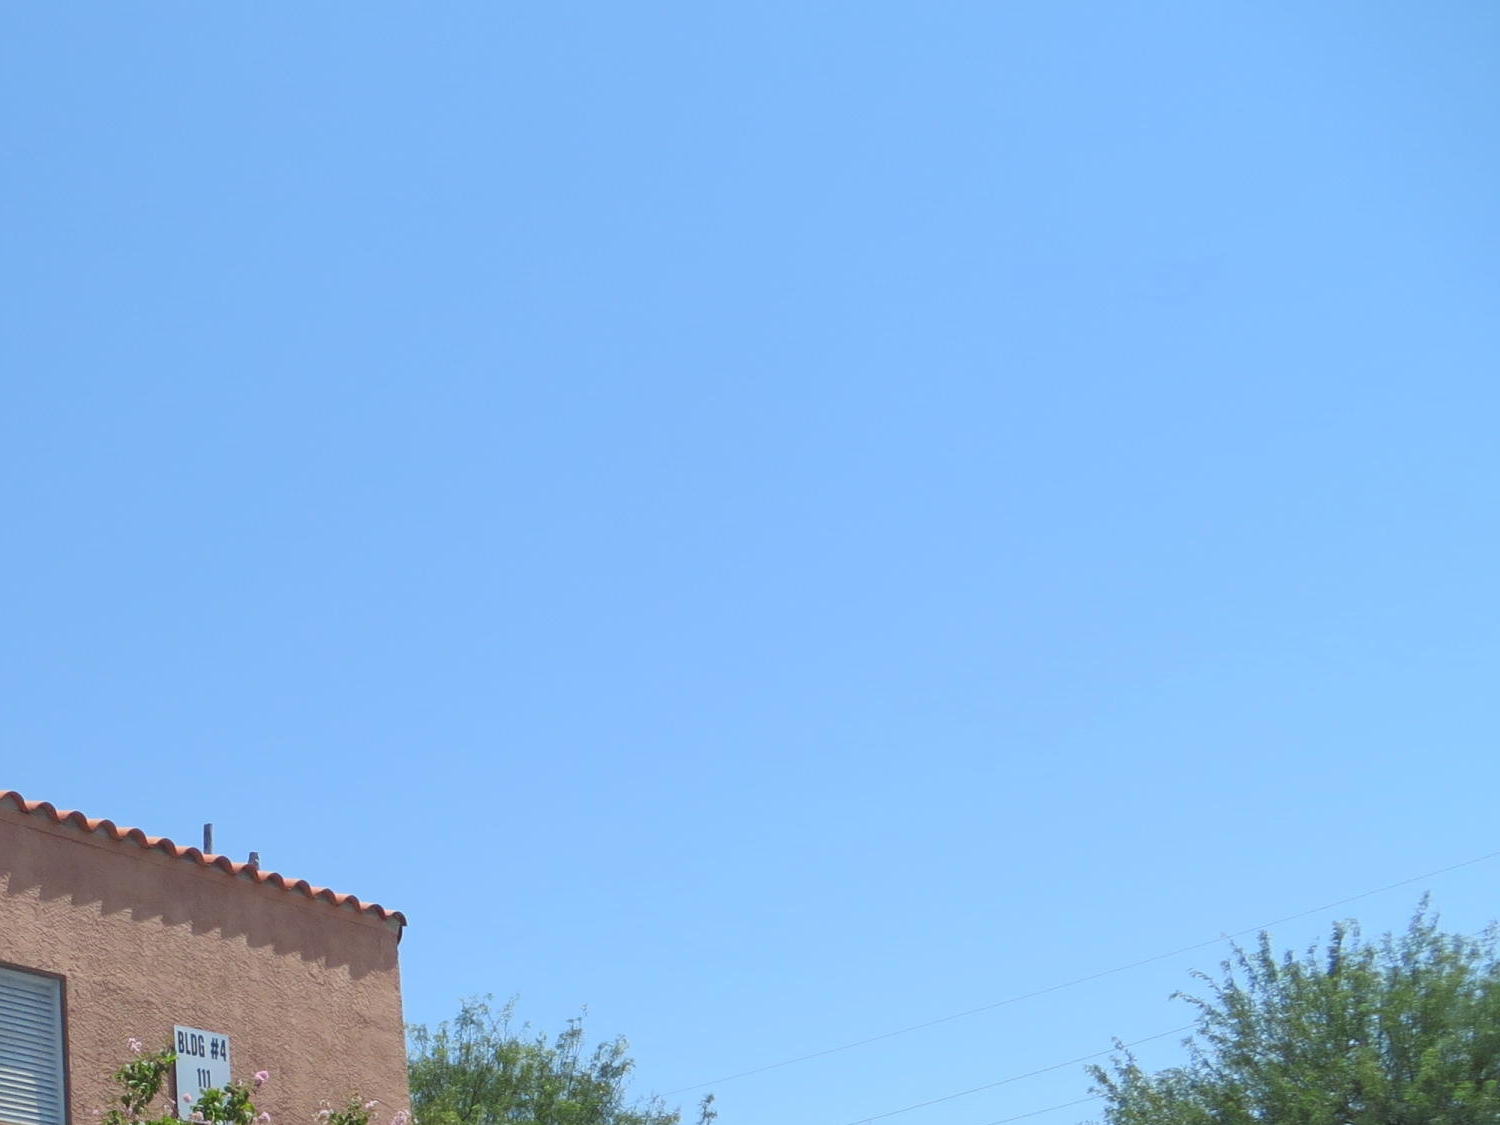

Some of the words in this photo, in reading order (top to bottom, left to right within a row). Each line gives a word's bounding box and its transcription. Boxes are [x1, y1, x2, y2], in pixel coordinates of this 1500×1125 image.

[177, 1031, 205, 1058] BLDG
[211, 1037, 227, 1062] #4
[197, 1068, 211, 1088] 111
